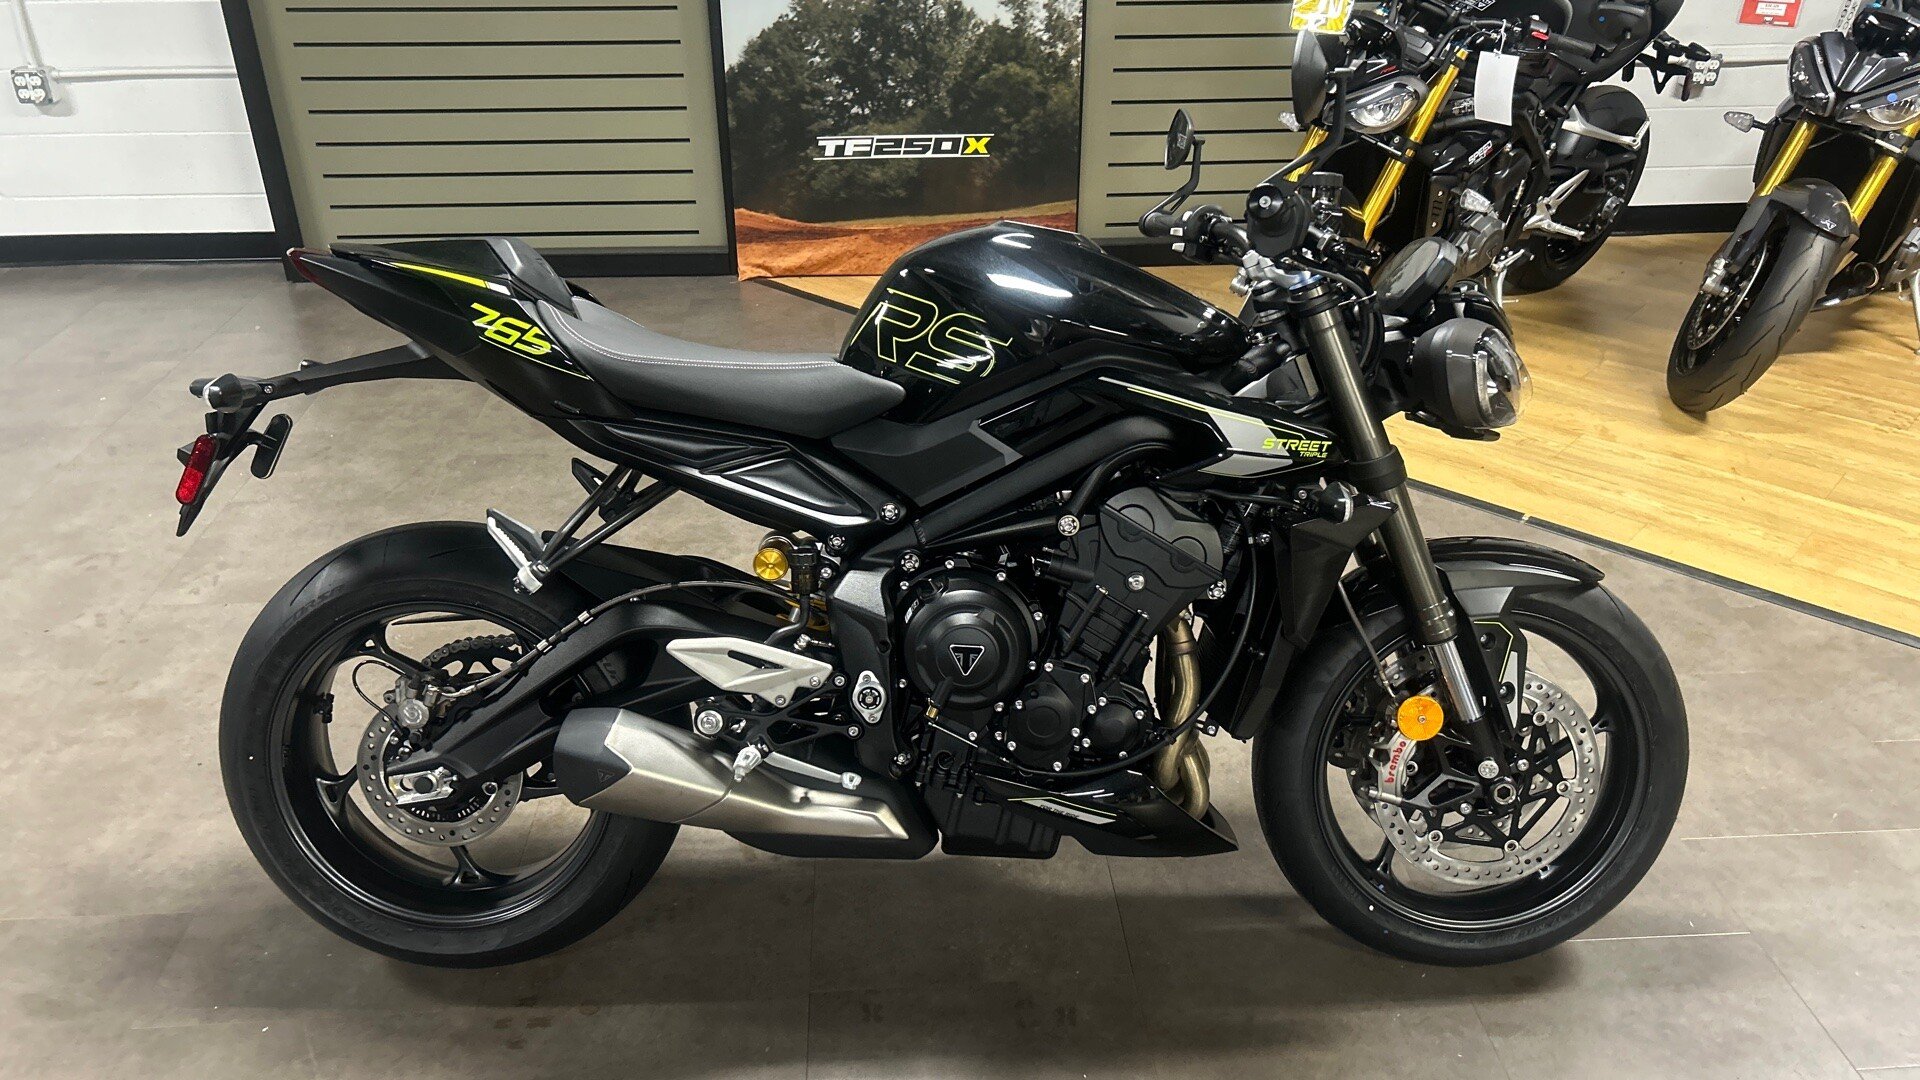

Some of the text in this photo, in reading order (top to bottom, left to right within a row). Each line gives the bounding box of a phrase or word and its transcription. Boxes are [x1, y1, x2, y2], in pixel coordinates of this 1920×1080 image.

[817, 135, 992, 158] TF250X
[470, 302, 552, 355] 765
[850, 287, 1014, 385] RS
[1262, 438, 1332, 452] STREET
[1384, 740, 1407, 783] brembo
